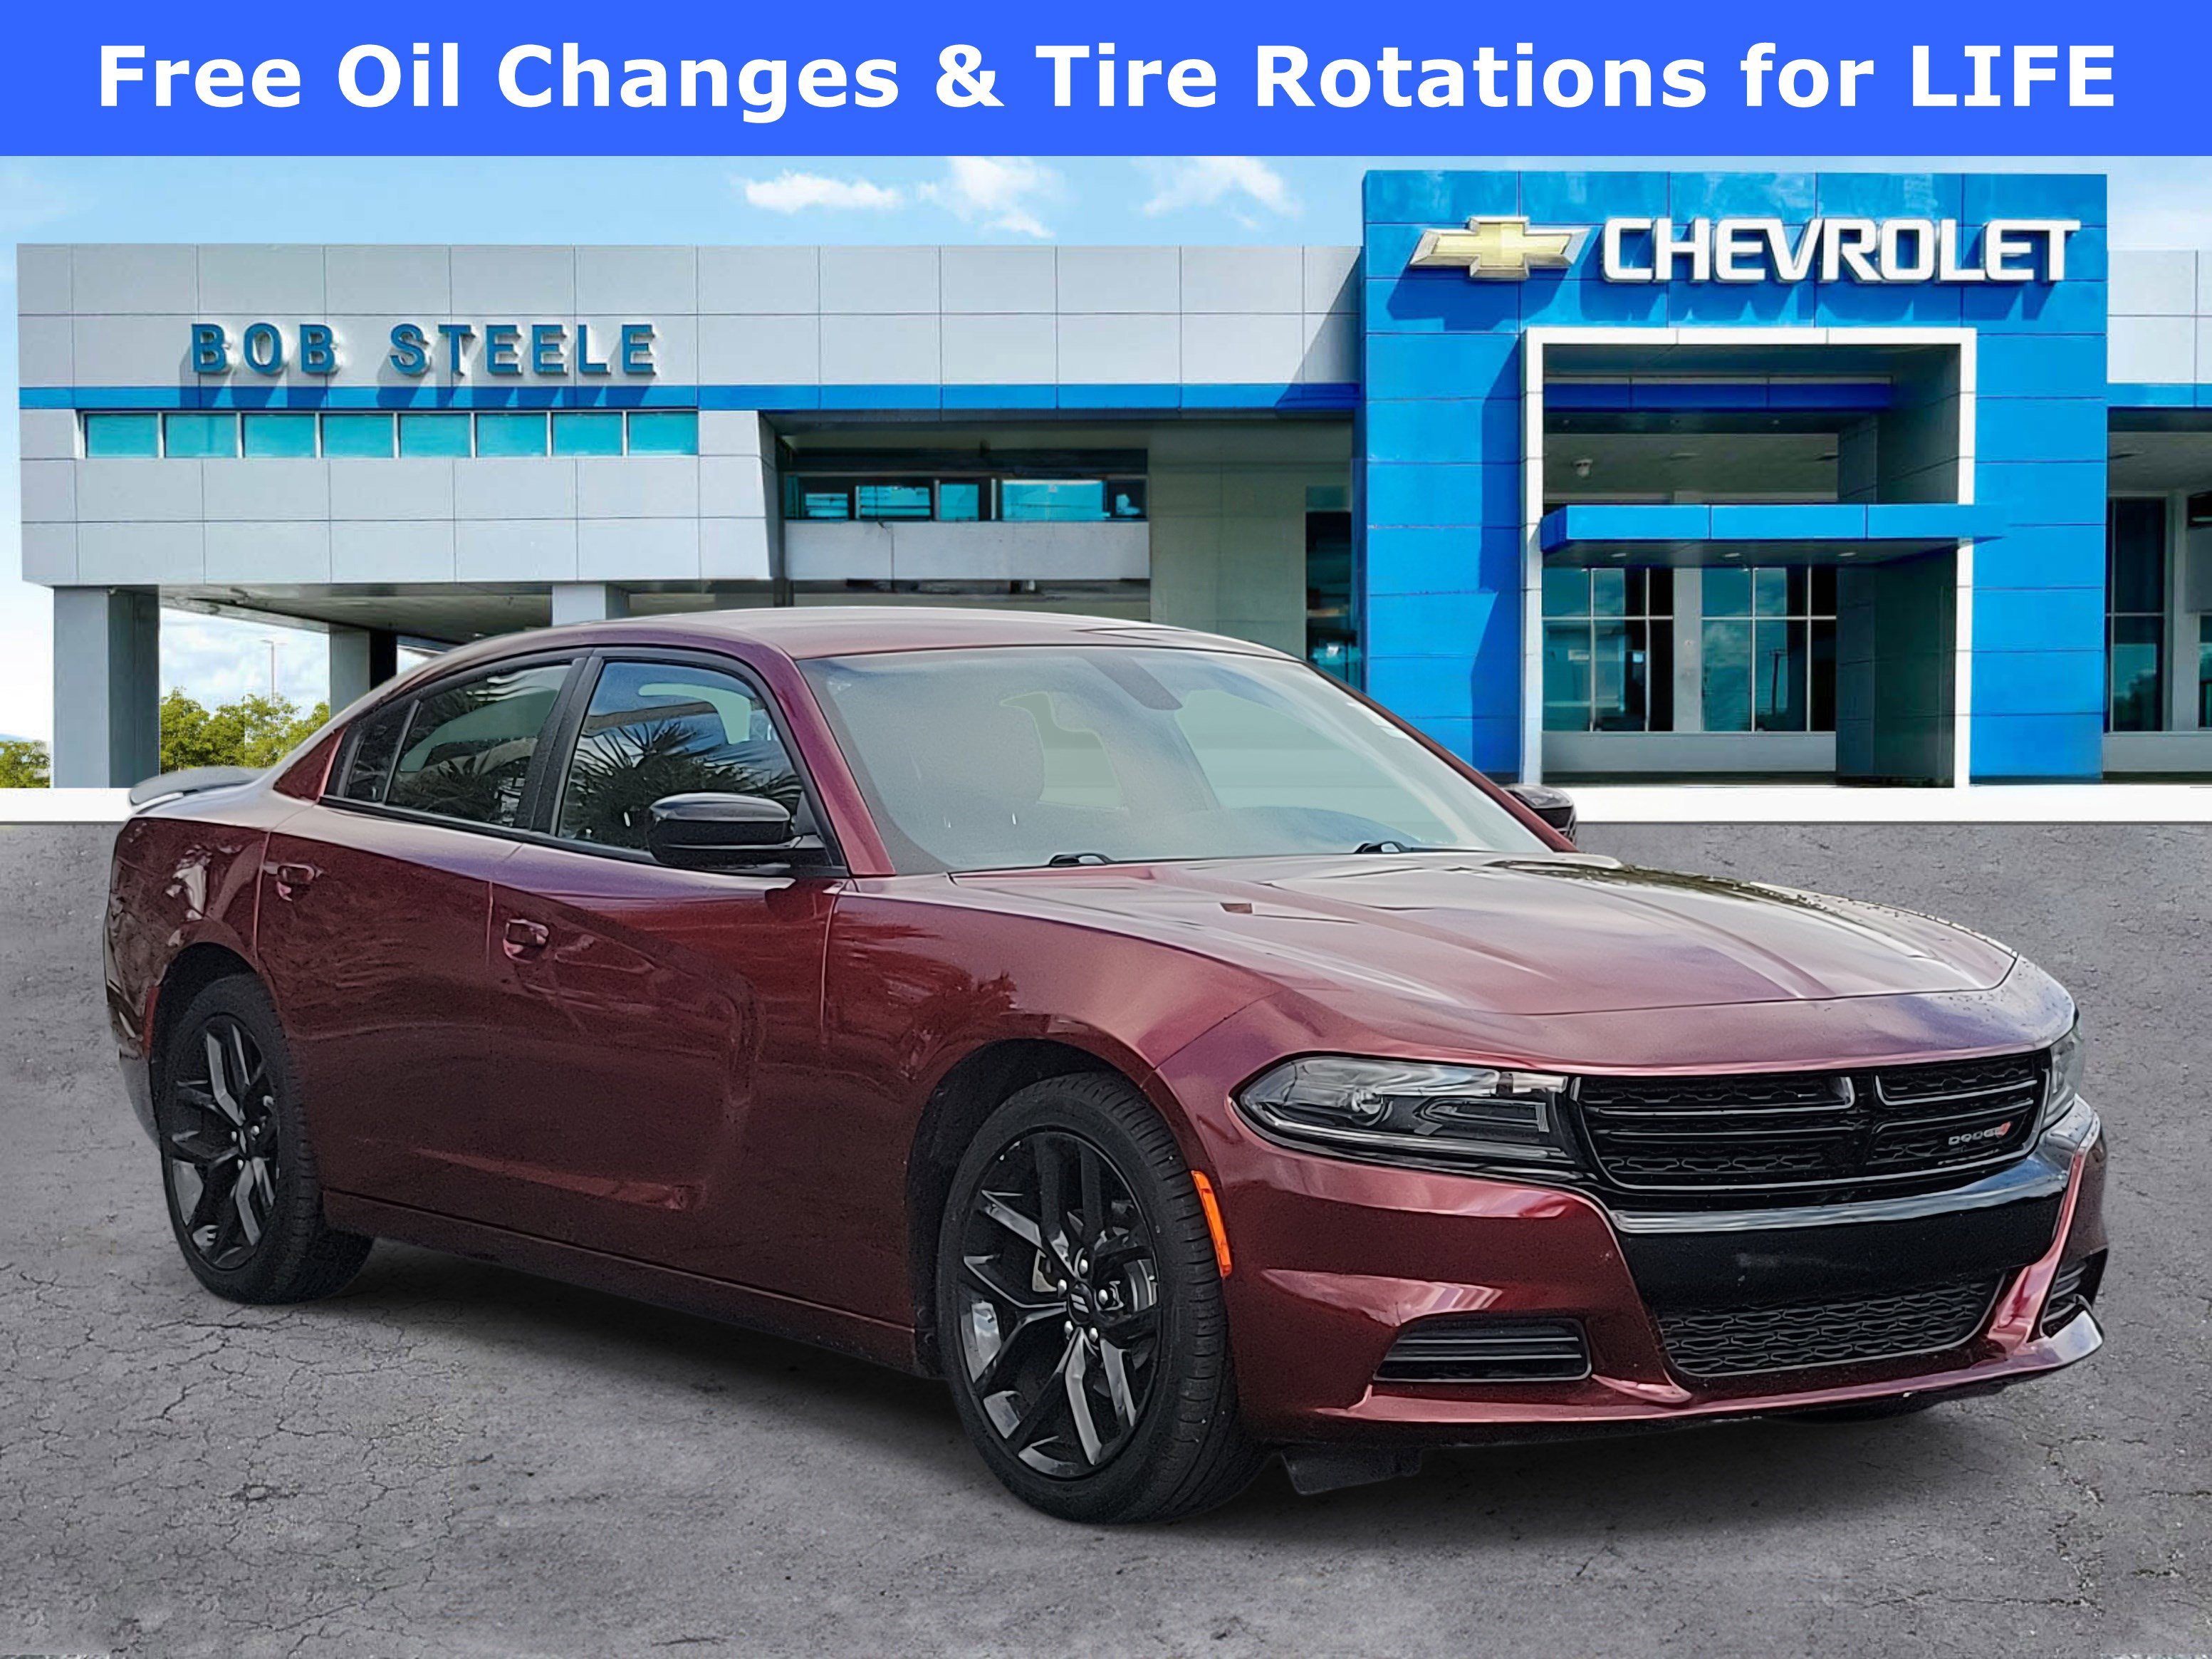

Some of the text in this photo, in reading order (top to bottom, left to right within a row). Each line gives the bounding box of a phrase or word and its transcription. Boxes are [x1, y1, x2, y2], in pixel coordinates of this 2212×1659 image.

[1602, 217, 2082, 284] CHEVROLET
[191, 323, 657, 375] BOB STEELE
